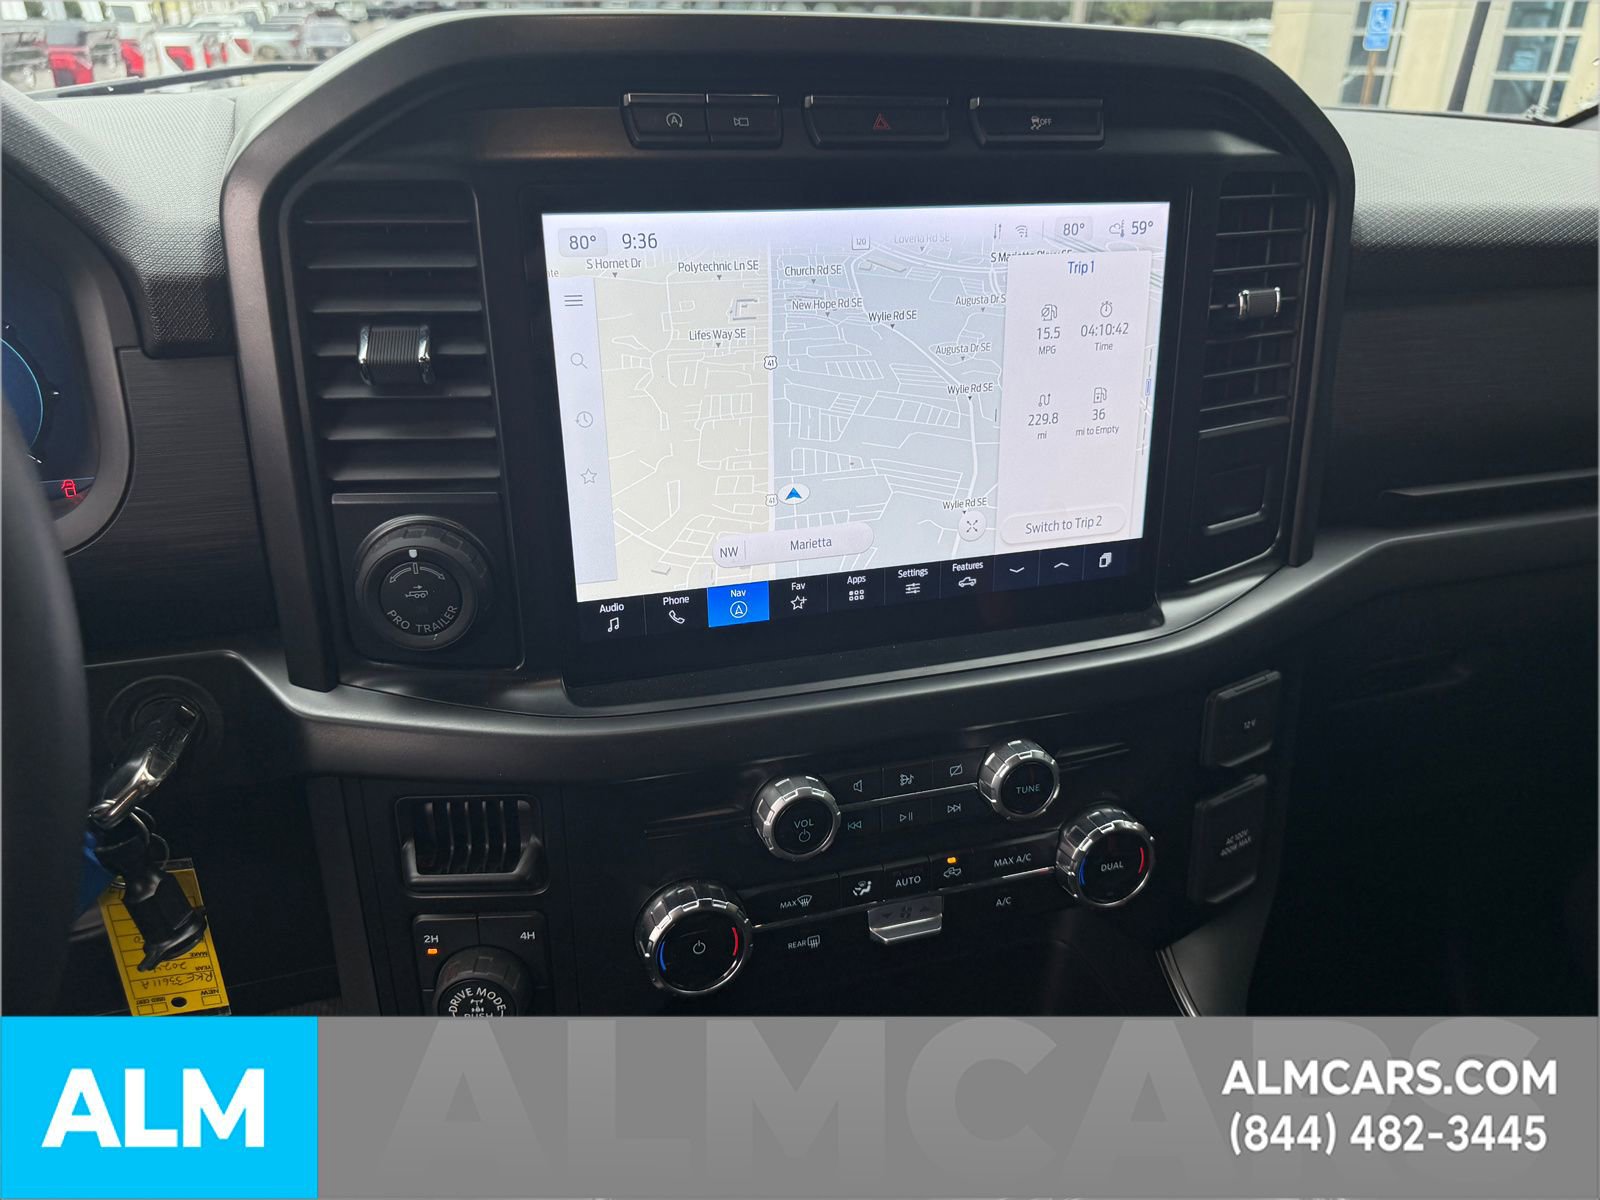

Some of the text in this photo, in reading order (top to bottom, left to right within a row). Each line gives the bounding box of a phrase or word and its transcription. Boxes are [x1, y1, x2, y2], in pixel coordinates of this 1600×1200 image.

[1040, 118, 1052, 127] OFF
[1063, 222, 1086, 237] 80°
[1131, 220, 1154, 235] 59°
[568, 234, 597, 250] 80°
[621, 232, 659, 251] 9:36
[855, 237, 867, 246] 120
[585, 257, 642, 270] S Hornet Dr
[677, 260, 759, 274] Polytechnic Ln SE
[1067, 260, 1095, 276] Trip 1
[784, 264, 842, 277] Church Rd SE
[792, 297, 863, 312] New Hope Rd SE
[955, 294, 1007, 307] Augusta Dr S
[868, 310, 918, 323] Wylie Rd SE
[688, 328, 747, 343] Lifes Way SE
[1036, 326, 1061, 340] 15.5
[1080, 321, 1130, 338] 04:10:42
[935, 342, 991, 356] Augusta Dr SE
[1038, 344, 1057, 356] MPG
[1094, 341, 1114, 352] Time
[947, 382, 993, 396] Wylie Rd SE
[1027, 412, 1060, 428] 229.8
[1091, 408, 1106, 421] 36
[1037, 430, 1047, 440] mi
[1075, 424, 1120, 437] mi to Empty
[942, 497, 988, 511] Wylie Rd SE
[1025, 515, 1103, 535] Switch to Trip 2
[789, 537, 833, 552] Marietta
[719, 546, 739, 558] NW
[897, 566, 929, 580] Settings
[952, 560, 984, 573] Features
[847, 573, 867, 586] Apps
[791, 581, 806, 592] Fav
[662, 594, 690, 606] Phone
[730, 588, 747, 599] Nav
[599, 601, 625, 614] Audio
[386, 604, 458, 634] PRO TRAILER
[1015, 784, 1041, 795] TUNE
[793, 819, 815, 830] VOL
[993, 853, 1032, 868] MAX A/C
[1100, 861, 1124, 873] DUAL
[895, 875, 922, 888] AUTO
[779, 901, 797, 910] MAX
[995, 897, 1012, 907] A/C
[423, 934, 440, 944] 2H
[519, 931, 536, 941] 4H
[787, 939, 807, 950] REAR
[200, 989, 220, 997] NEW
[448, 986, 507, 1014] DRIVE MODE
